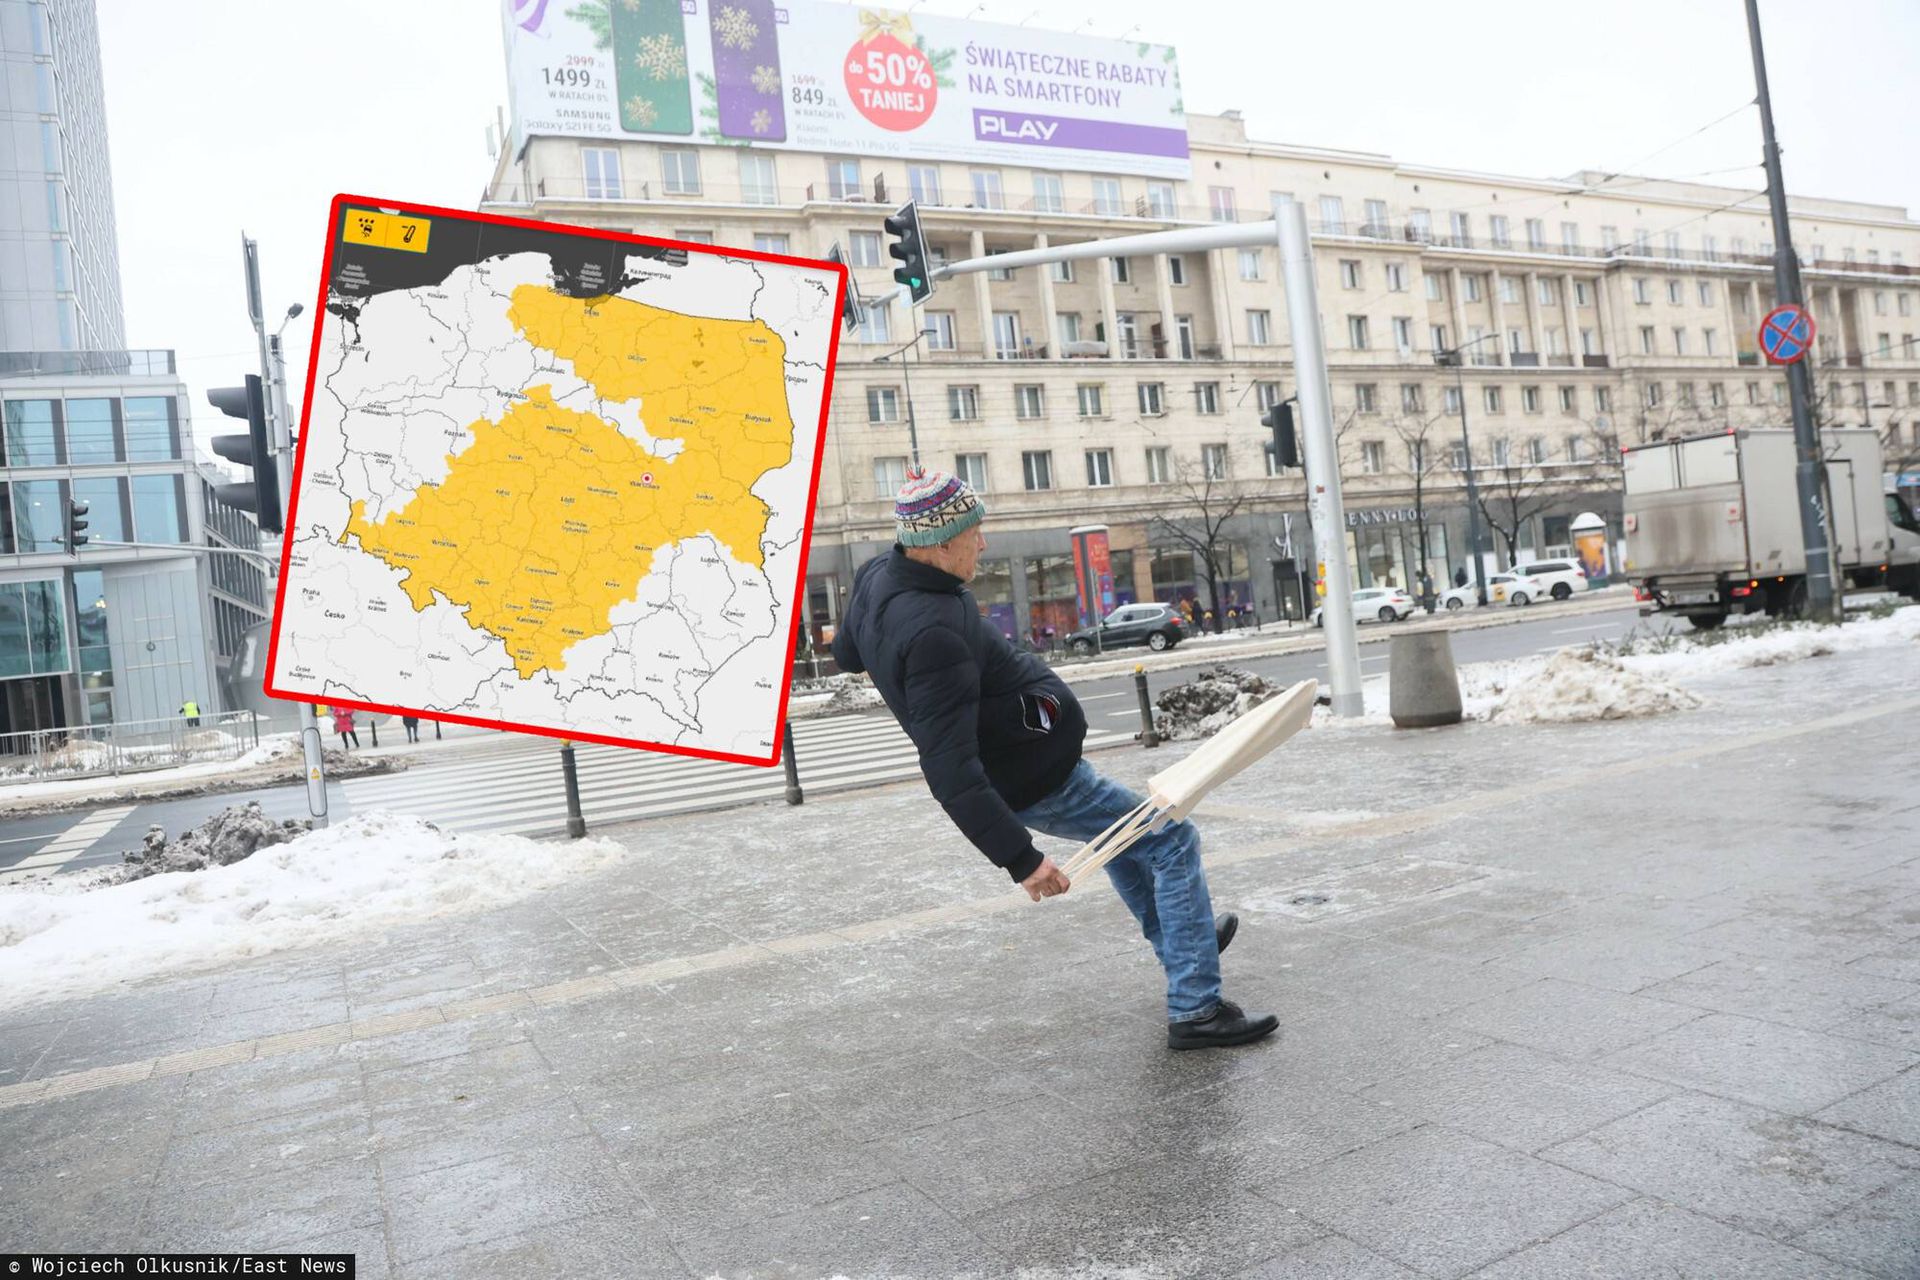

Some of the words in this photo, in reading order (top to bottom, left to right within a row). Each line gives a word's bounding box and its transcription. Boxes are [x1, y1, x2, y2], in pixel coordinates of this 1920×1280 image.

[848, 60, 863, 75] do
[866, 51, 933, 90] 50%
[965, 40, 1091, 79] ŚWIĄTECZNE
[1097, 62, 1168, 88] RABATY
[541, 67, 590, 88] 1499
[791, 87, 824, 105] 849
[859, 88, 925, 113] TANIEJ
[968, 73, 997, 96] NA
[1004, 77, 1122, 109] SMARTFONY
[556, 109, 611, 120] SAMSUNG
[979, 115, 1059, 141] PLAY
